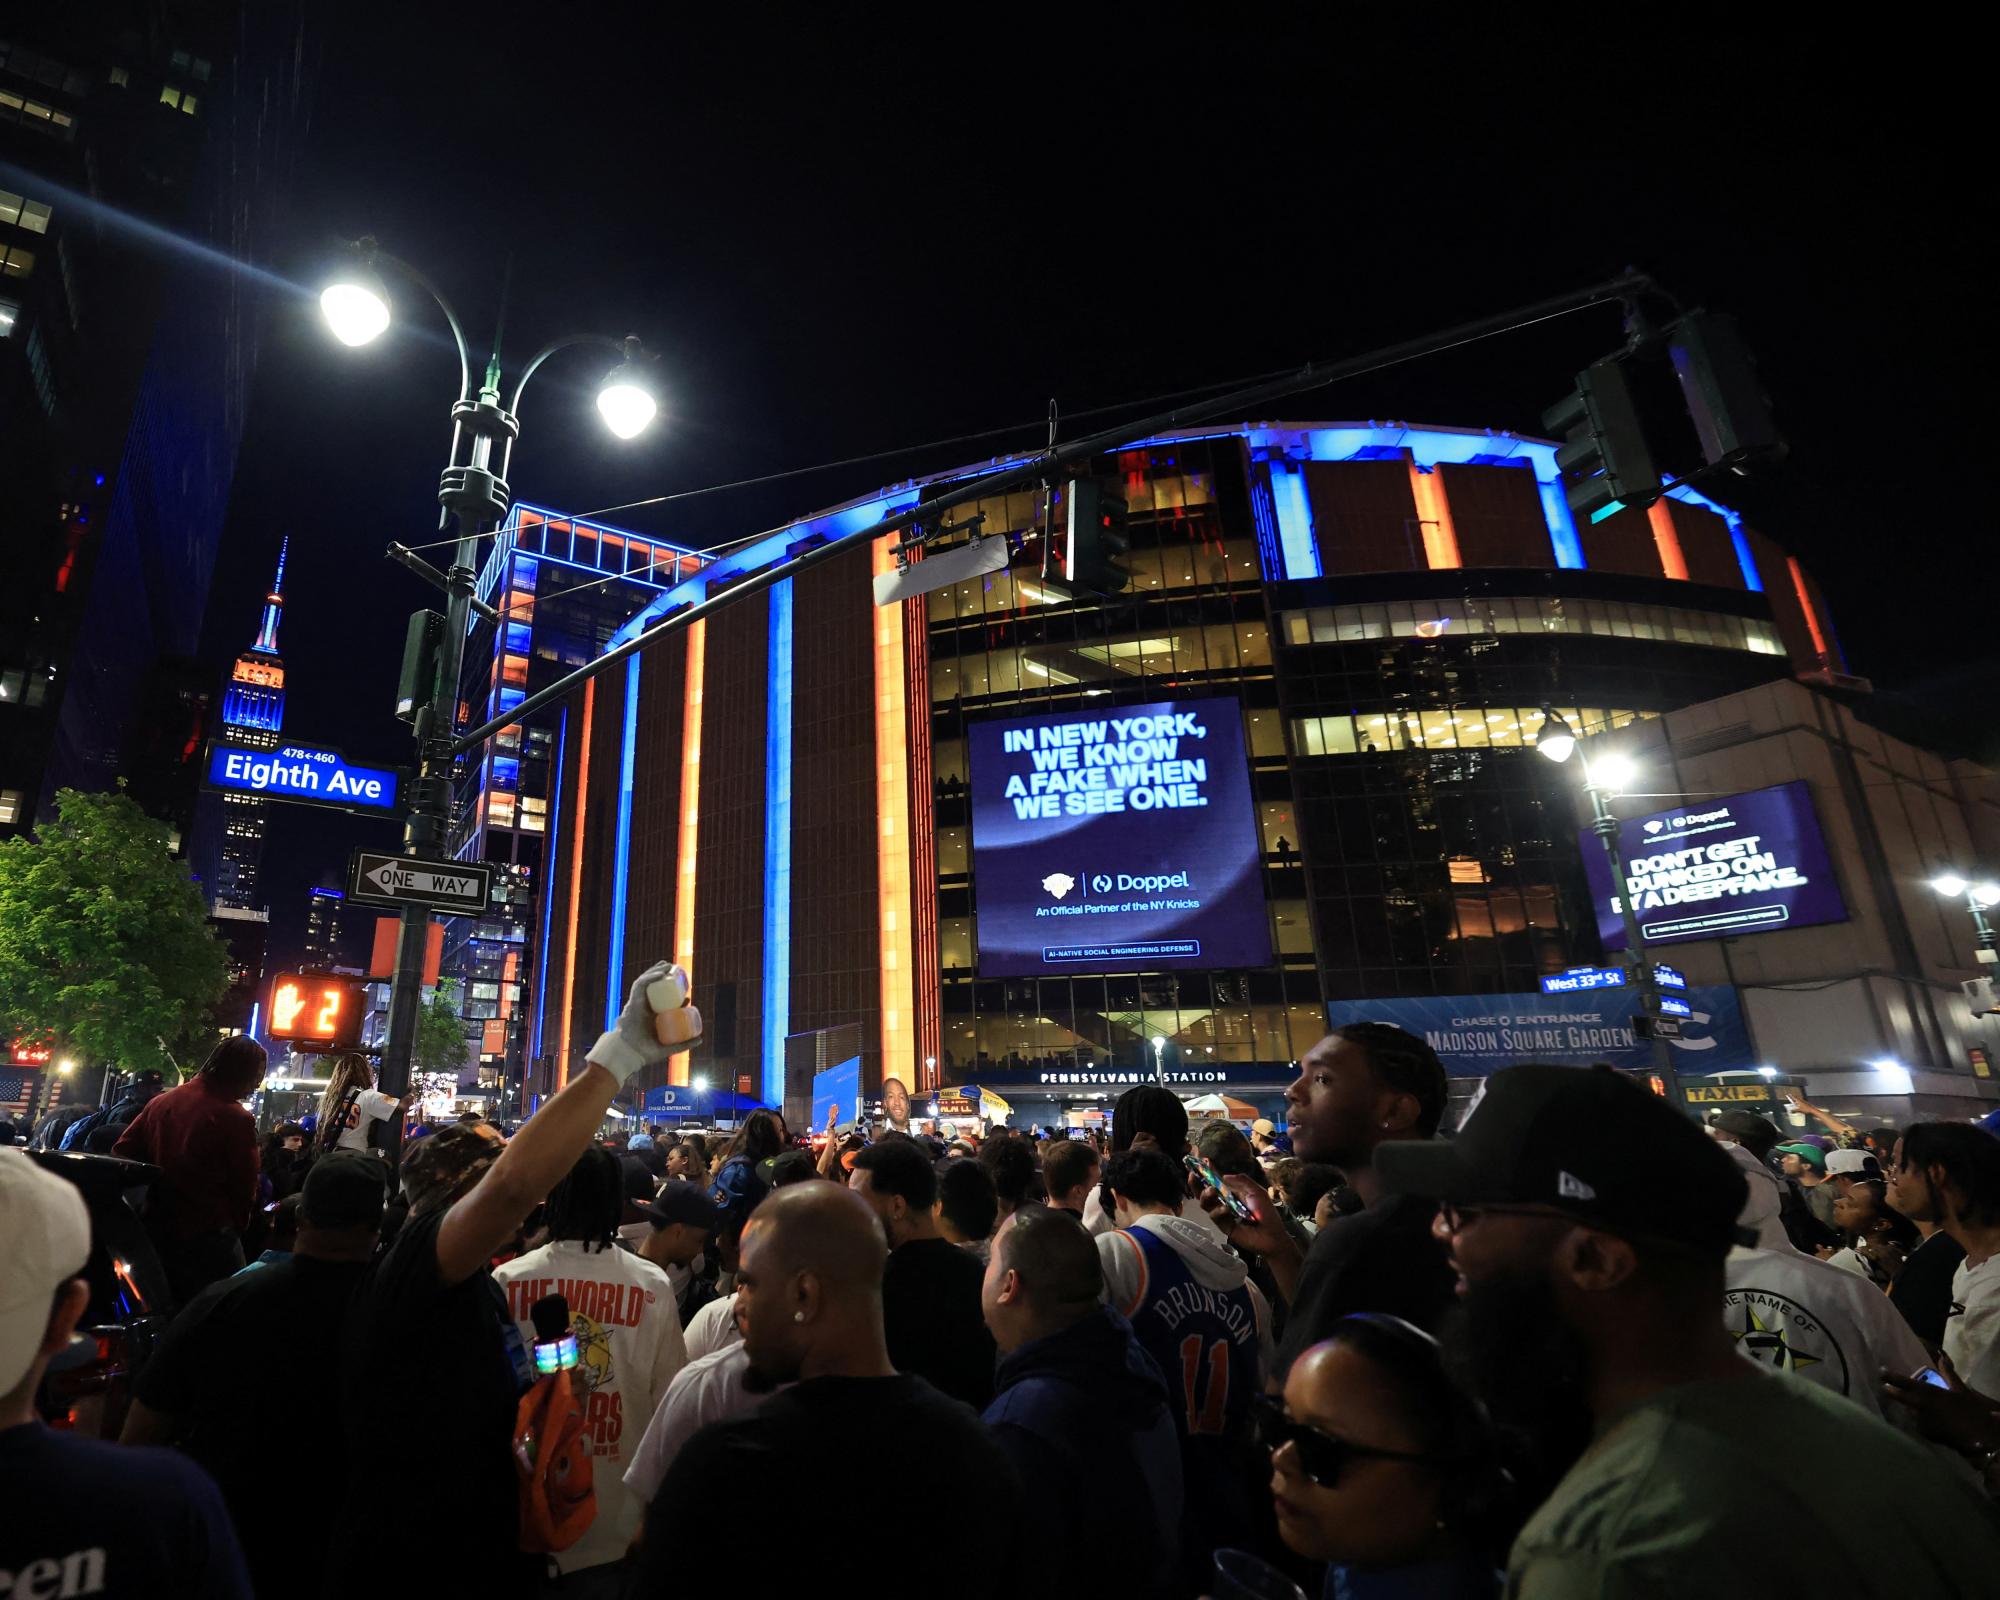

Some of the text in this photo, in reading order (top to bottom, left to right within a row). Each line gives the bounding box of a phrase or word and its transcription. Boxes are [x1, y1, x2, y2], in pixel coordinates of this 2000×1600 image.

[1003, 712, 1206, 752] IN NEW YORK,
[283, 748, 336, 764] 478 460
[1032, 738, 1178, 771] WE KNOW
[224, 754, 382, 798] Eighth Ave
[1004, 759, 1206, 798] A FAKE WHEN
[1013, 783, 1208, 820] WE SEE ONE.
[1626, 852, 1776, 895] DUNKED ON
[1630, 836, 1760, 877] DON'T GET
[380, 869, 470, 894] ONE WAY
[1118, 871, 1189, 893] Doppel
[1644, 891, 1665, 909] A
[1663, 867, 1808, 906] DEEPFAKE.
[1035, 898, 1200, 917] An Official Partner of the NY Knicks
[1048, 944, 1194, 958] AI-NATIVE SOCIAL ENGINEERING DEFENSE
[1546, 972, 1621, 991] West 33rd St
[317, 990, 341, 1032] 2
[1452, 1013, 1602, 1027] CHASE ENTRANCE
[1426, 1026, 1634, 1051] MADISON SQUARE GARDEN
[1041, 1072, 1227, 1084] PENNSYLVANIA STATION
[1689, 1087, 1739, 1101] TAXI
[664, 1090, 676, 1104] D
[558, 1278, 645, 1328] WORLD
[1153, 1282, 1253, 1345] BRUNSON
[1723, 1292, 1818, 1335] HE NAME OF
[1180, 1333, 1230, 1434] 11
